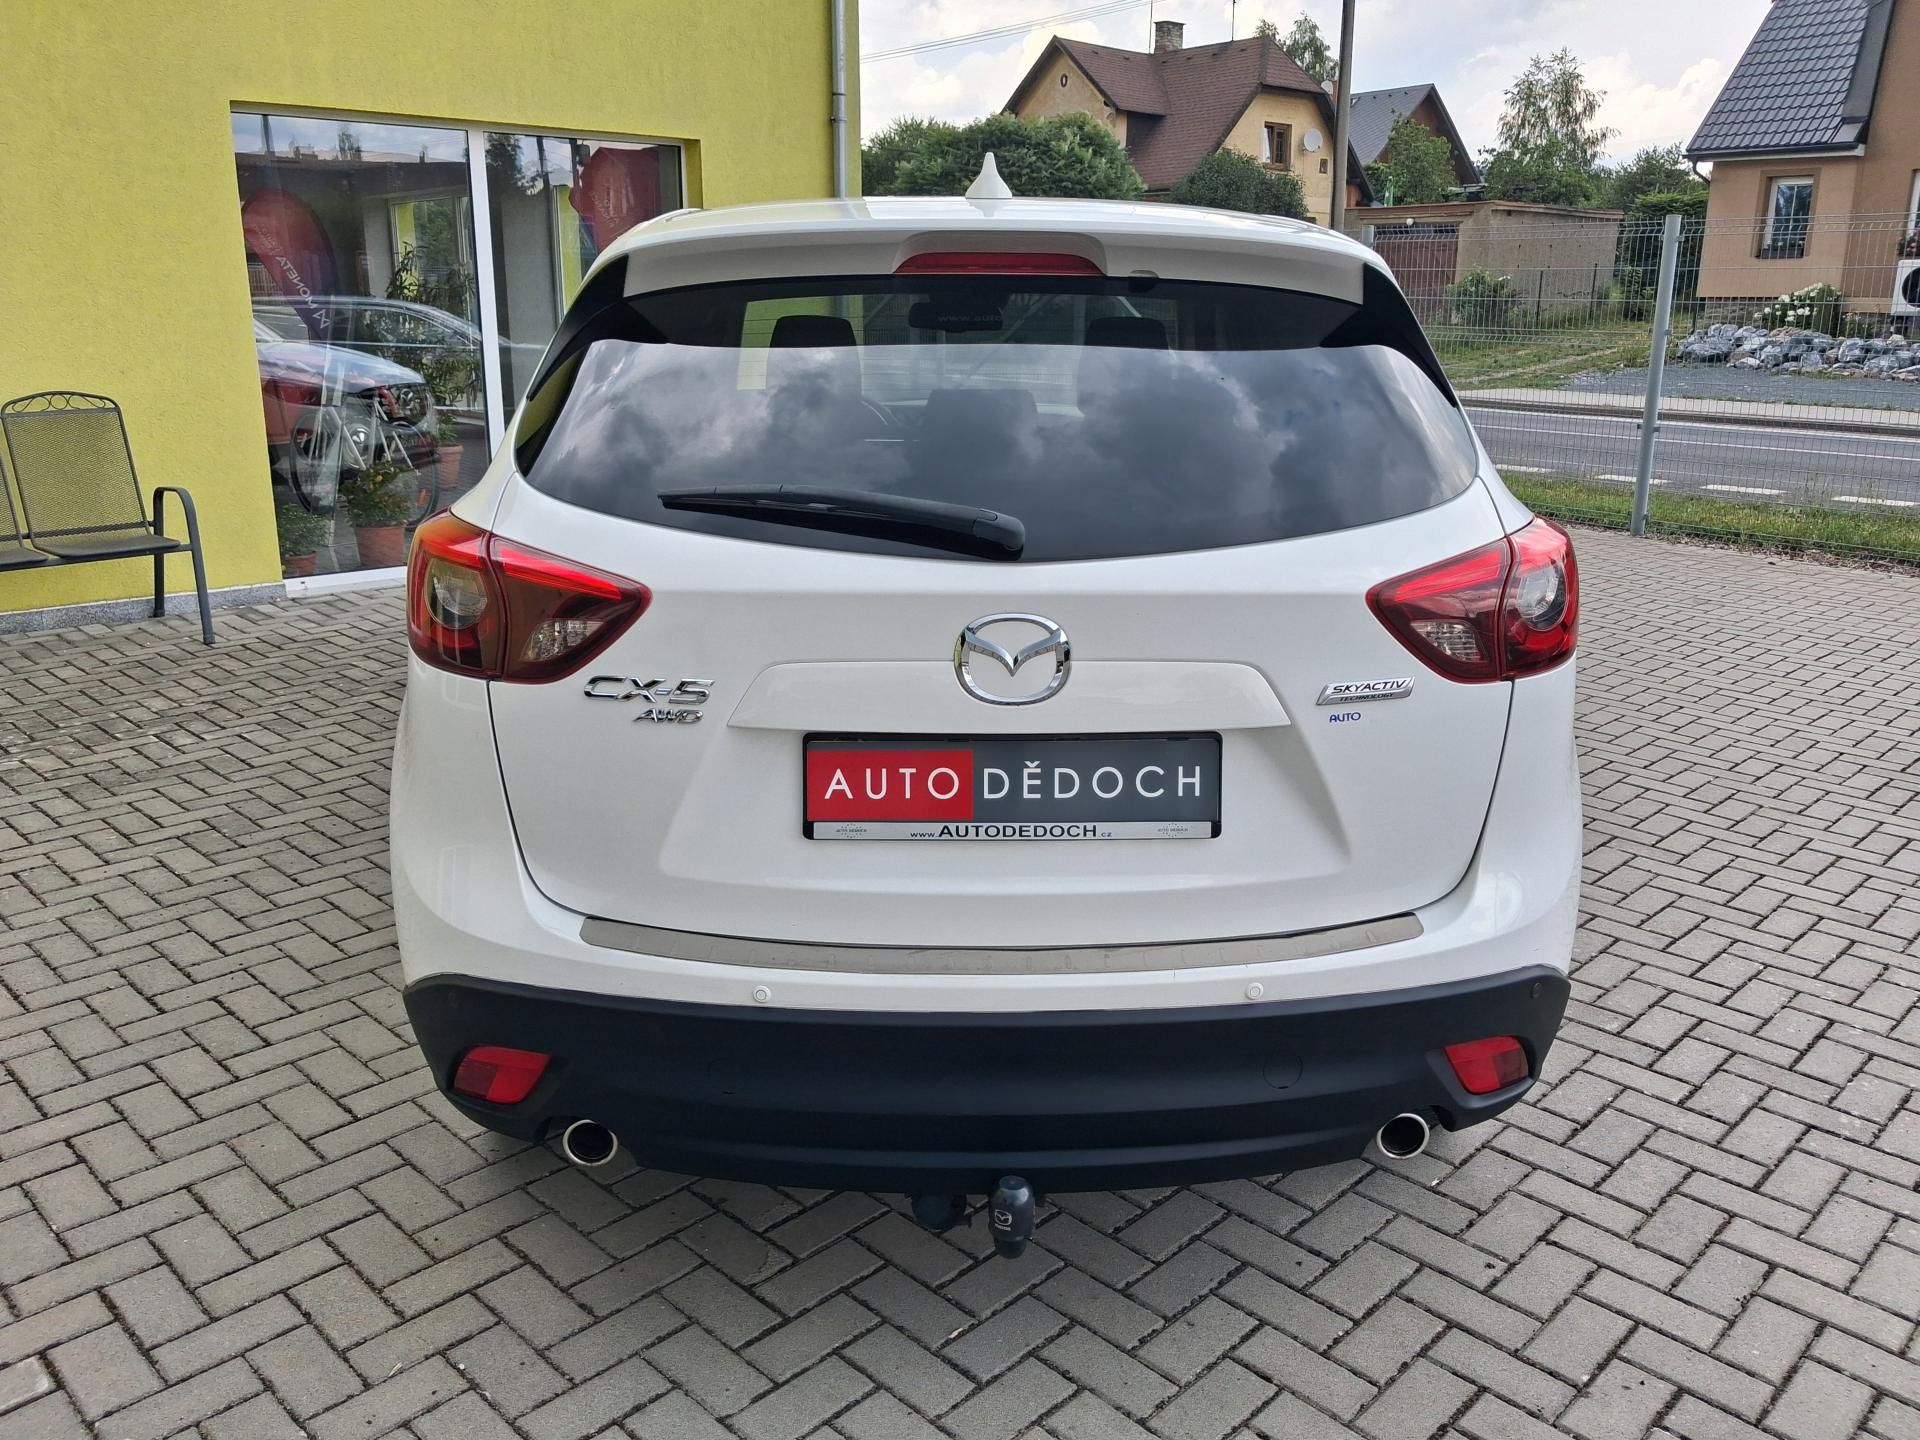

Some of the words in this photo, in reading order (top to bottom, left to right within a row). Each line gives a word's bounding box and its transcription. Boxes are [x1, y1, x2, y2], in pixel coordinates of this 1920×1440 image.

[583, 675, 716, 705] CX-5
[1332, 680, 1406, 694] SKYACTIV
[1340, 693, 1393, 702] TECHNOLOGY
[632, 707, 704, 725] AWD
[1328, 711, 1362, 723] AUTO
[824, 767, 960, 800] AUTO
[983, 760, 1201, 800] DĚDOCH
